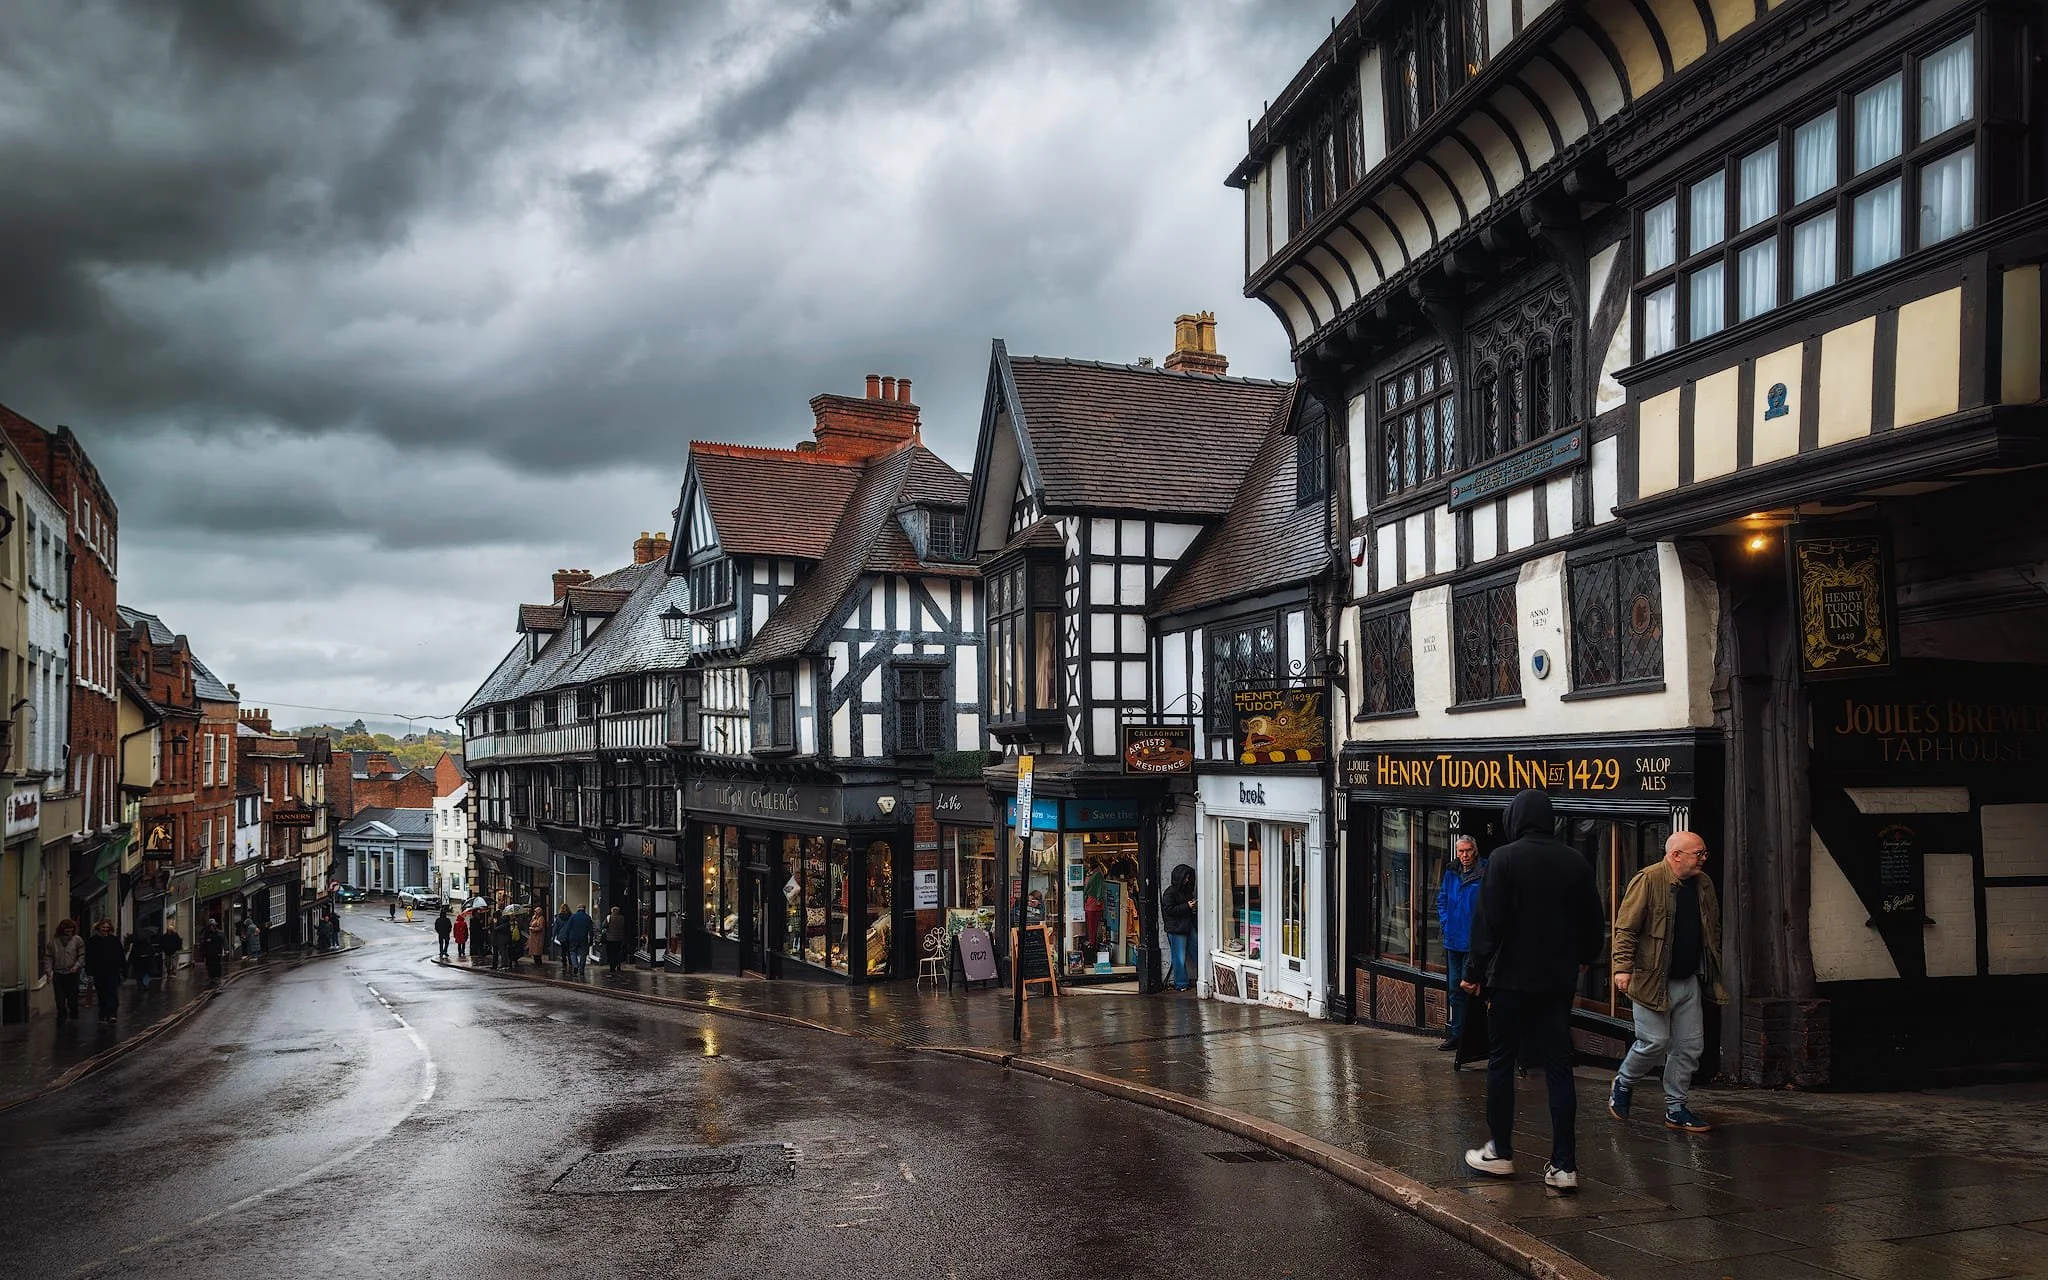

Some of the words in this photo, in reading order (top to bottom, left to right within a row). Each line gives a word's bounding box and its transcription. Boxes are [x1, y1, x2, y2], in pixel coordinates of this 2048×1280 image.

[1825, 591, 1862, 603] HENRY
[1530, 608, 1549, 618] ANNO
[1825, 602, 1863, 614] TUDOR
[1829, 612, 1860, 629] INN
[1837, 633, 1856, 641] 1429
[1234, 690, 1283, 701] HENRY
[1234, 701, 1283, 712] TUDOR
[1835, 697, 1940, 735] JOULE'S
[1129, 738, 1165, 755] ARTISTS
[1876, 737, 2033, 762] TAPHOUSE
[1135, 759, 1185, 772] RESIDENCE
[1377, 754, 1434, 787] HENRY
[1436, 754, 1505, 789] TUDOR
[1507, 754, 1547, 790] INN
[1566, 758, 1620, 790] 1429
[1635, 757, 1671, 773] SALOP
[1354, 773, 1368, 785] SONS
[1640, 776, 1667, 791] ALES
[1239, 781, 1266, 806] brok
[751, 791, 799, 812] GALLERIES
[1092, 810, 1116, 820] Save
[1118, 809, 1134, 819] the
